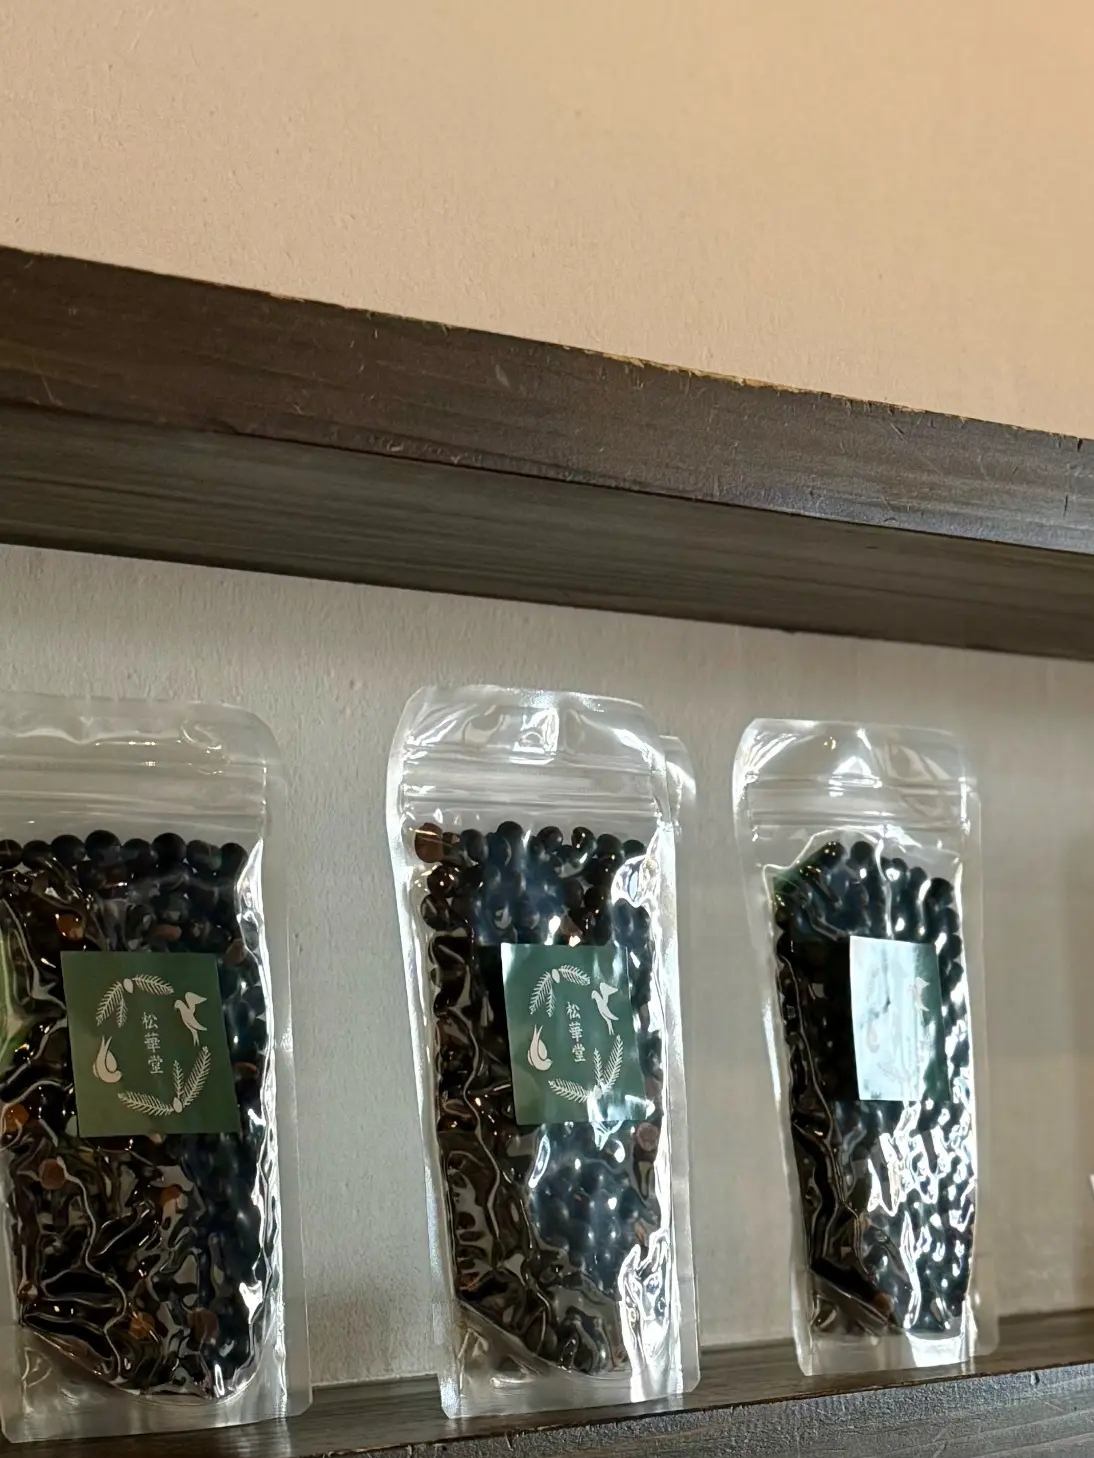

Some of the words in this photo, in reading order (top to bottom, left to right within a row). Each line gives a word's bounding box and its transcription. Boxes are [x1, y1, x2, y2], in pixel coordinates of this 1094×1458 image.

[142, 1012, 163, 1074] 松華堂
[566, 1002, 586, 1062] 松華堂
